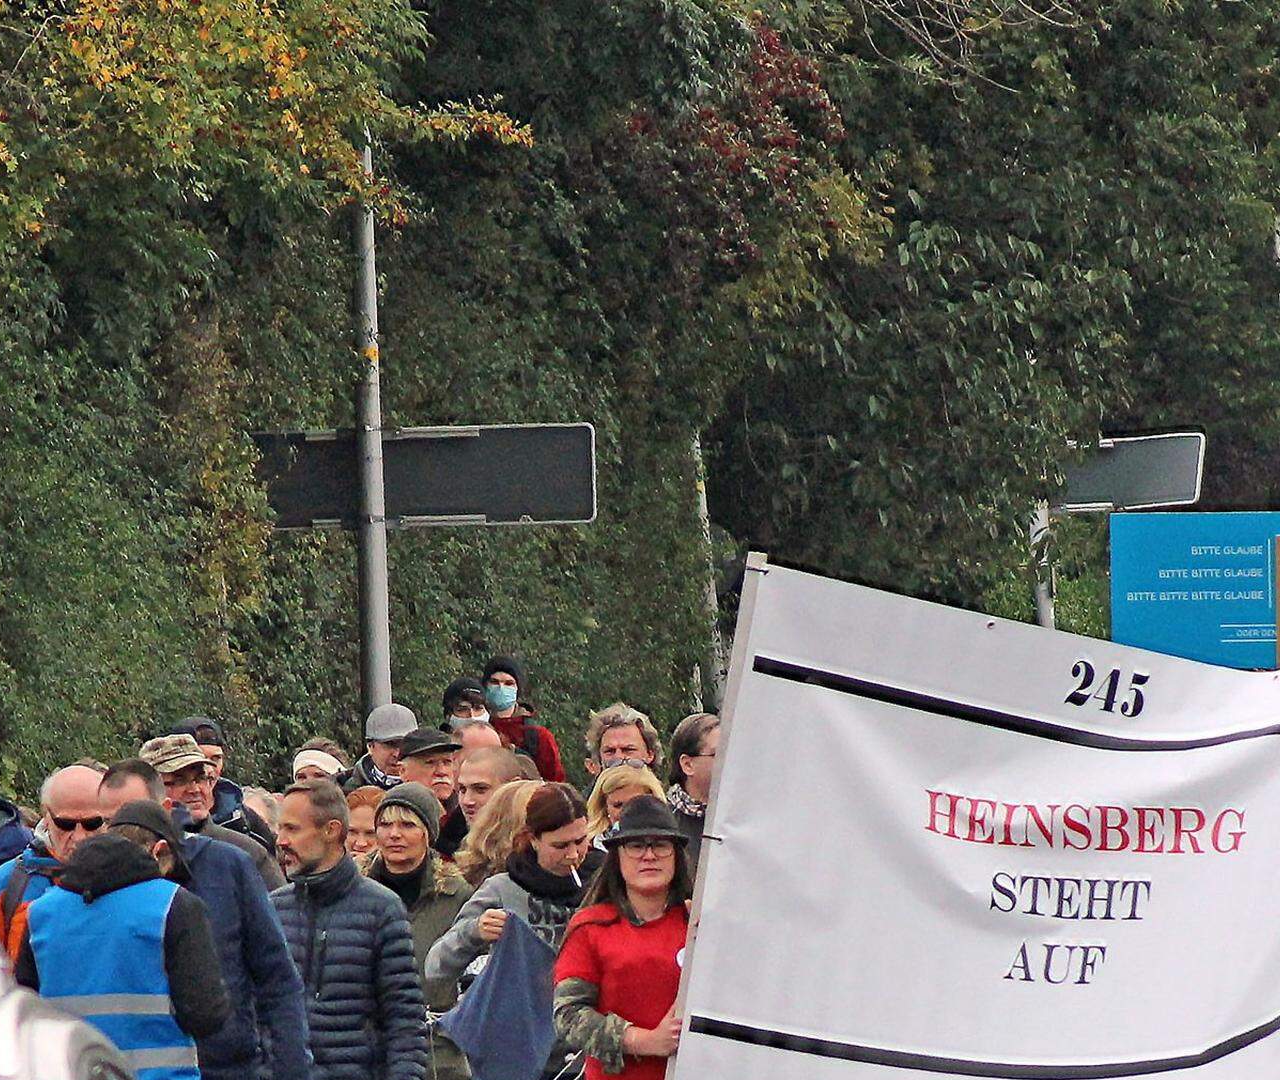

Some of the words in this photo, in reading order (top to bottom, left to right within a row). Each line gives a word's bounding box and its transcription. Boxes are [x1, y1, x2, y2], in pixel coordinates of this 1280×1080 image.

[1191, 545, 1221, 556] BITTE
[1223, 545, 1263, 555] GLAUBE
[1158, 569, 1188, 579] BITTE
[1191, 568, 1221, 578] BITTE
[1223, 568, 1263, 577] GLAUBE
[1126, 592, 1157, 601] BITTE
[1159, 592, 1189, 601] BITTE
[1191, 591, 1221, 600] BITTE
[1223, 590, 1264, 600] GLAUBE
[1064, 659, 1151, 718] 245
[924, 789, 1247, 855] HEINSBERG
[989, 871, 1152, 921] STEHT
[1004, 942, 1107, 985] AUF
